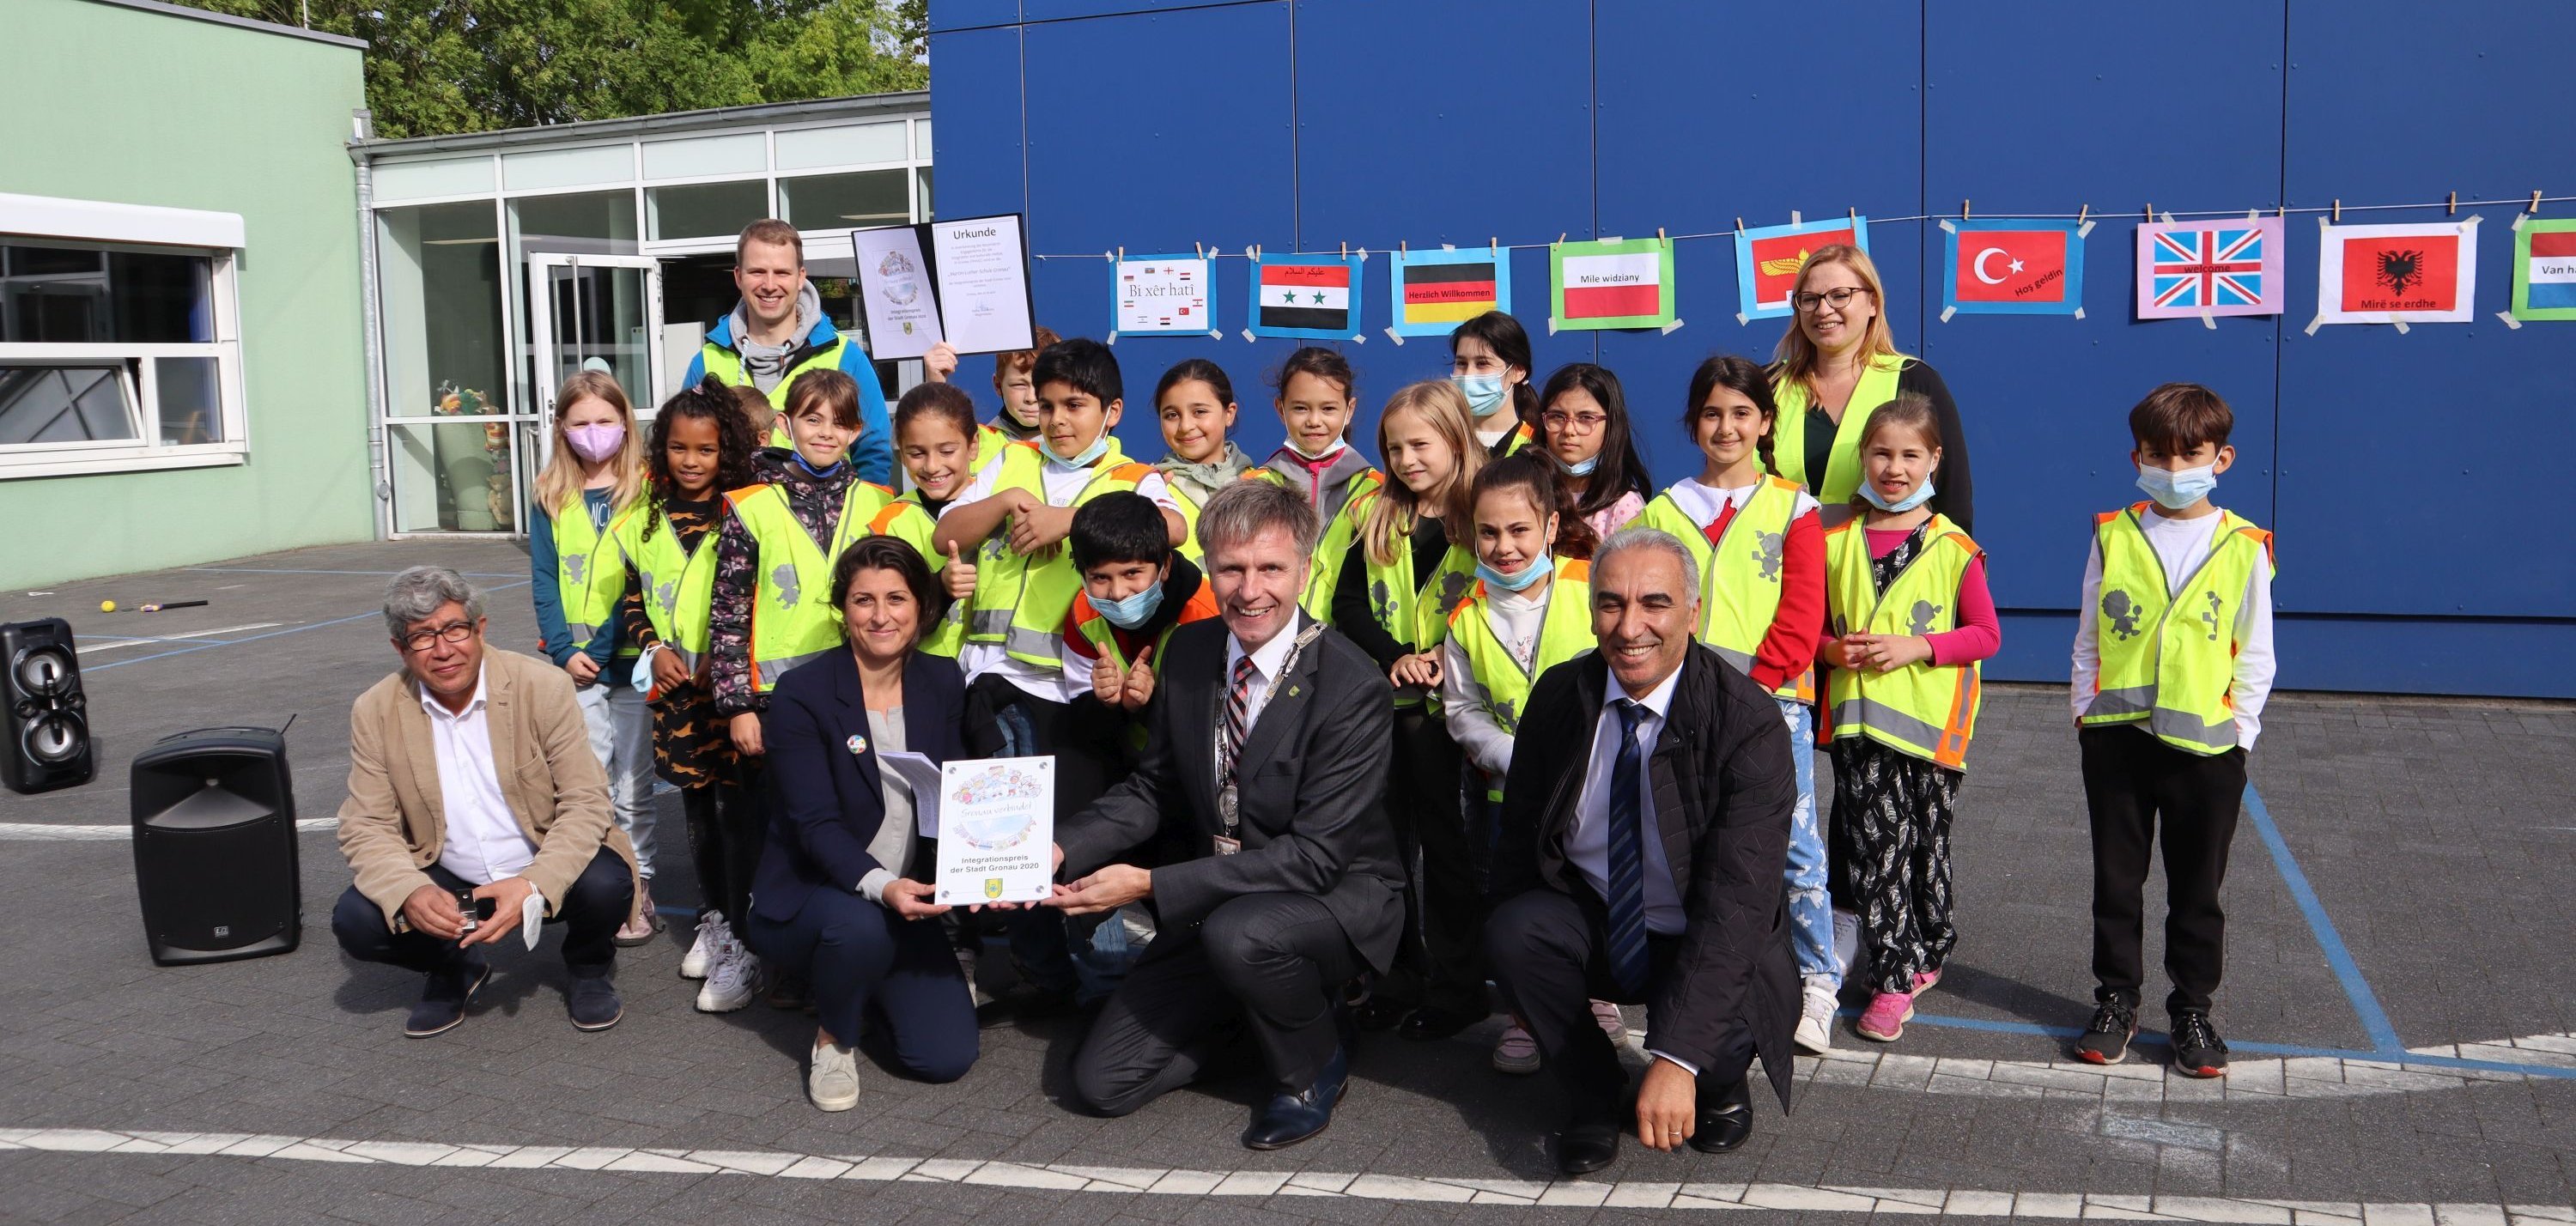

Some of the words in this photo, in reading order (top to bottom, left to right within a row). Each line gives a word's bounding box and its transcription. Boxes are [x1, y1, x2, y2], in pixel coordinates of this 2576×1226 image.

[953, 227, 997, 240] Urkunde
[2184, 264, 2231, 273] welcome
[2542, 265, 2564, 275] Van
[1580, 274, 1601, 283] Mile
[1602, 273, 1640, 283] widziany
[2014, 283, 2034, 297] Hoş
[2034, 269, 2063, 289] geldin
[1129, 284, 1142, 297] Bi
[1145, 284, 1166, 297] xêr
[1169, 282, 1196, 296] hatî
[1408, 290, 1439, 299] Herzlich
[1441, 289, 1491, 298] Willkommen
[2360, 298, 2387, 309] Mirë
[2390, 300, 2402, 309] se
[2403, 298, 2436, 308] erdhe
[961, 854, 1030, 865] Integrationspreis
